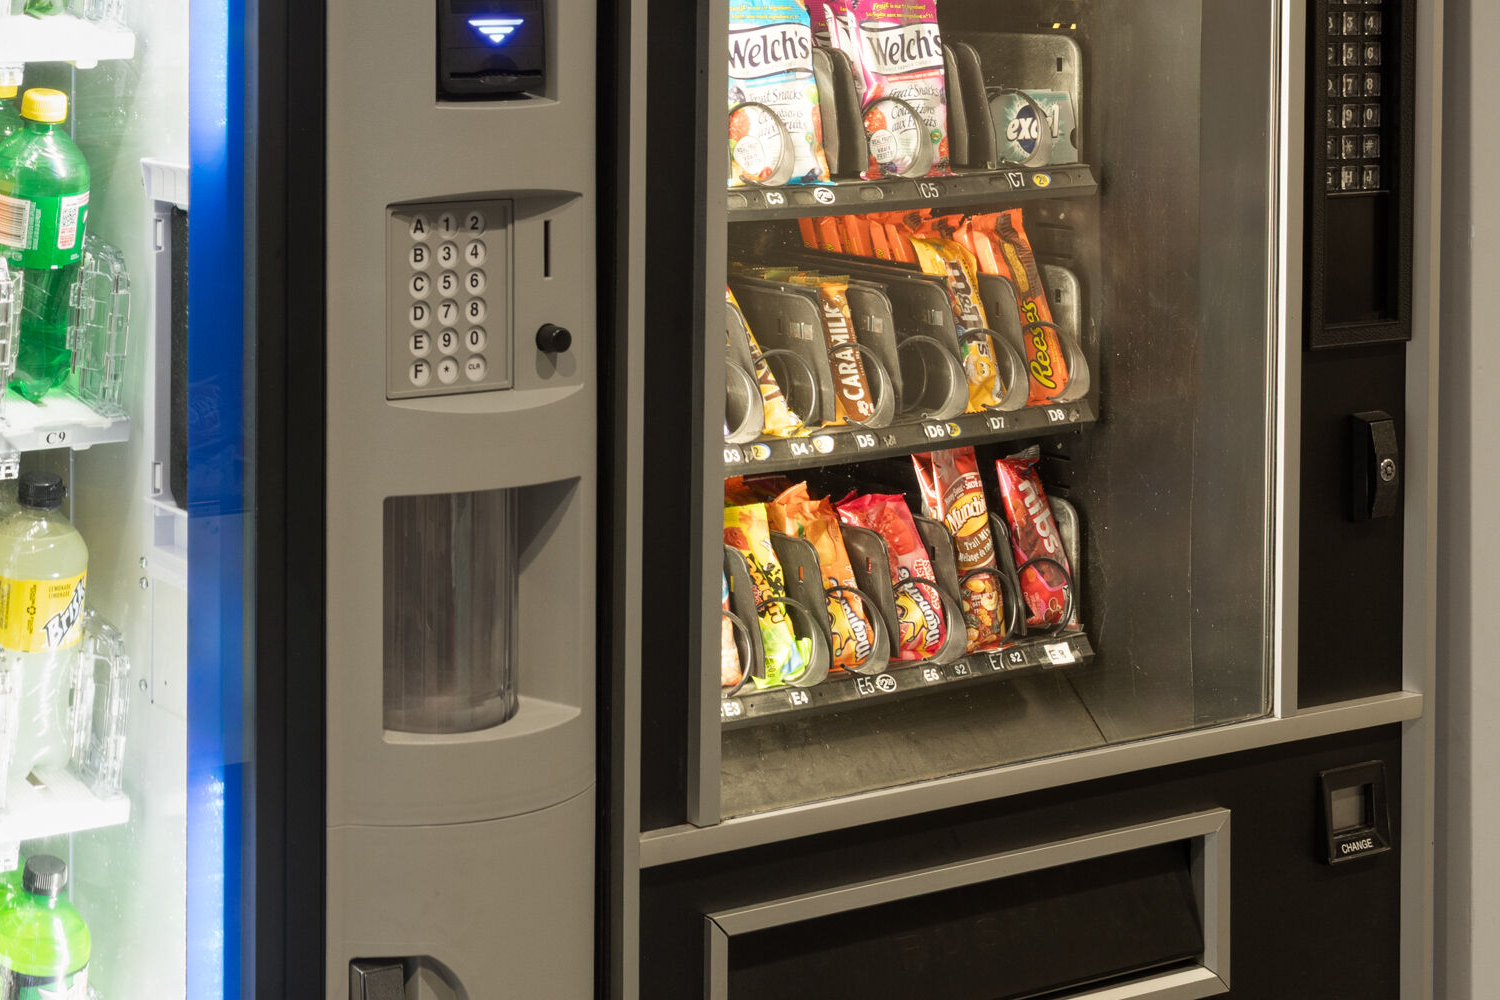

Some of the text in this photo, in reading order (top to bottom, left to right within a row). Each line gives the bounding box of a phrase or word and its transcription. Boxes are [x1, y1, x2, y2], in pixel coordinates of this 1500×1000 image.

[1367, 16, 1374, 28] 4
[728, 31, 810, 69] Welch's
[866, 29, 943, 66] Welch's
[1346, 47, 1353, 59] 5
[1367, 47, 1374, 59] 6
[1346, 79, 1352, 90] 7
[1366, 78, 1373, 90] 8
[913, 86, 941, 97] Snacks
[1346, 109, 1352, 121] 9
[1366, 109, 1373, 121] 0
[1008, 172, 1026, 187] C7
[920, 184, 939, 198] C5
[766, 192, 782, 204] C3
[413, 219, 425, 234] A
[443, 218, 449, 231] 1
[470, 217, 479, 230] 2
[414, 248, 424, 262] B
[442, 246, 451, 260] 3
[470, 245, 479, 258] 4
[413, 277, 424, 291] C
[442, 275, 451, 289] 5
[470, 274, 479, 287] 6
[414, 306, 424, 321] D
[443, 304, 451, 318] 7
[470, 303, 479, 316] 8
[415, 335, 424, 350] E
[442, 333, 451, 347] 9
[470, 331, 478, 345] 0
[825, 302, 865, 401] CARAMILK
[414, 364, 424, 379] F
[1048, 409, 1065, 421] D8
[990, 416, 1005, 430] D7
[928, 425, 944, 437] D6
[857, 435, 875, 447] D5
[791, 443, 808, 455] D4
[724, 451, 740, 463] D3
[1018, 480, 1059, 554] nibs
[964, 539, 979, 552] Trail
[989, 653, 1005, 671] E7
[1009, 651, 1022, 663] $2
[923, 668, 940, 682] E6
[955, 663, 967, 675] $2
[857, 681, 875, 695] E5
[791, 692, 808, 705] E4
[725, 704, 741, 716] E3
[1341, 838, 1373, 854] CHANGE
